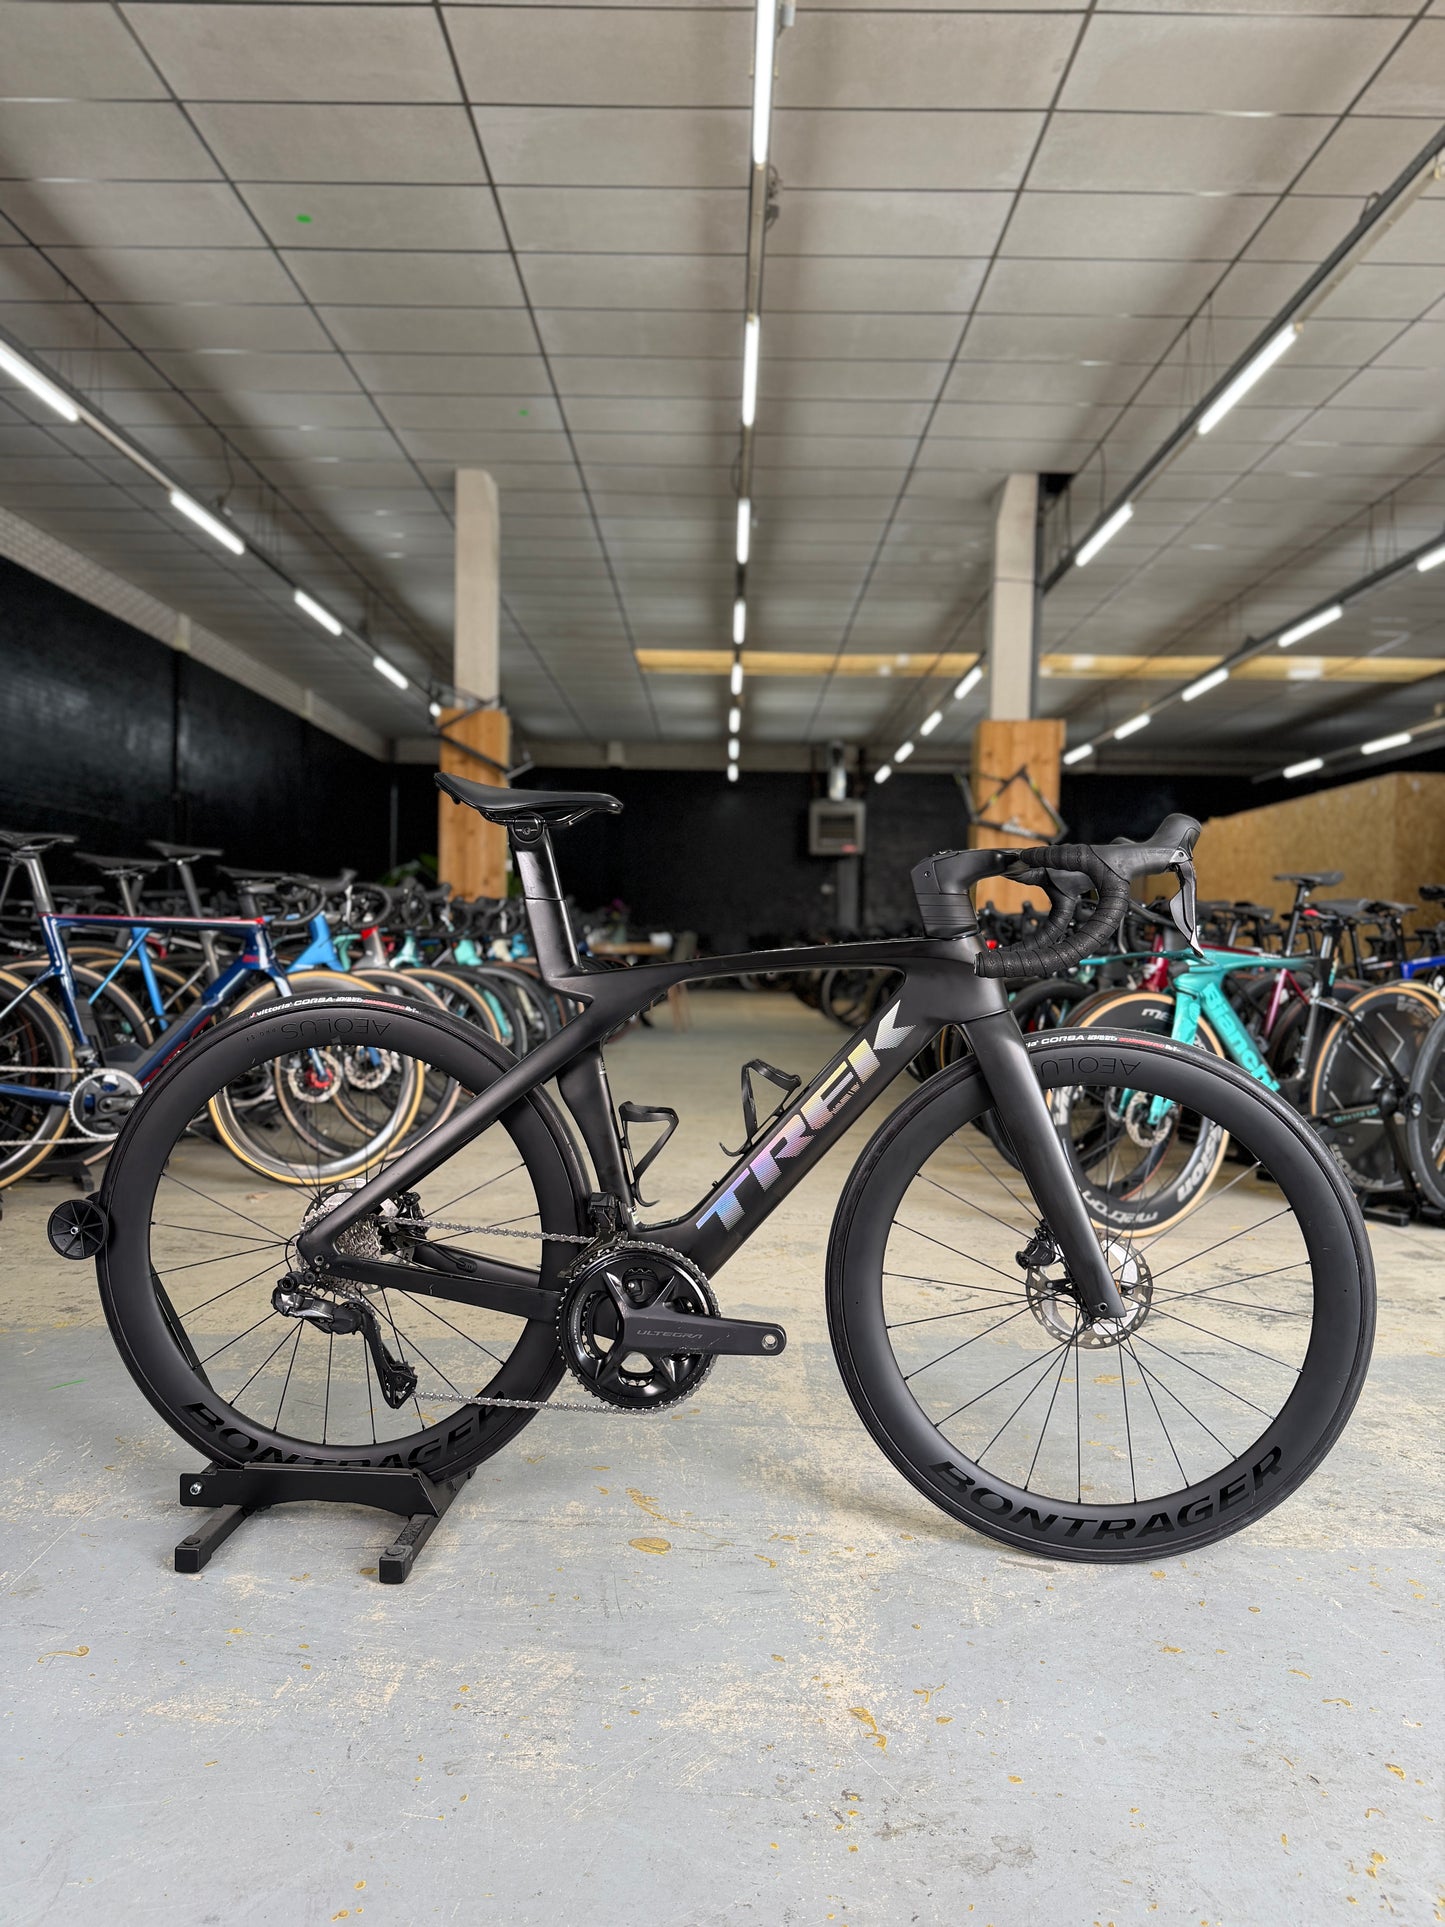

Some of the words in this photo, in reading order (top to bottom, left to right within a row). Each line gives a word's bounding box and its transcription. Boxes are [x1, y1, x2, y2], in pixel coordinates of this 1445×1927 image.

[256, 1003, 289, 1016] vittoria
[294, 997, 333, 1006] CORSA
[281, 1017, 391, 1040] AEOLUS
[1041, 1035, 1085, 1045] CORSA
[1033, 1056, 1142, 1079] AEOLU
[696, 999, 917, 1231] TREK
[636, 1329, 703, 1339] ULTEGRA
[928, 1445, 1283, 1540] BONTRAGER
